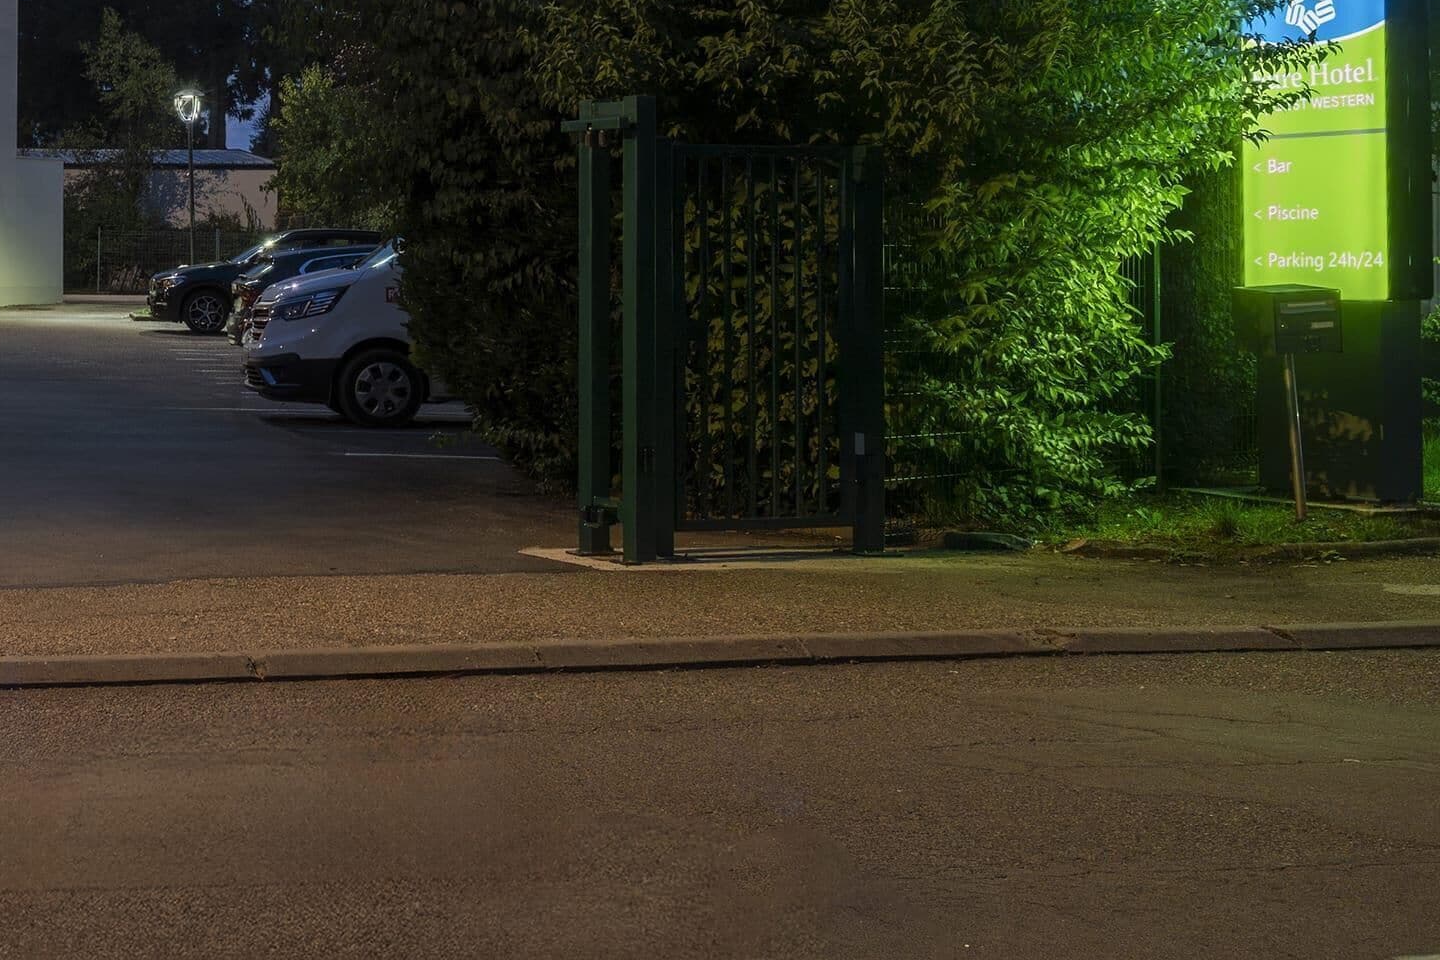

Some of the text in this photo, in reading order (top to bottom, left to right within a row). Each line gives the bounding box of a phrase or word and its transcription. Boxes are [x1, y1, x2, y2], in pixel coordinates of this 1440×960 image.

[1310, 57, 1373, 87] Hotel
[1312, 93, 1375, 109] WESTERN
[1267, 158, 1293, 174] Bar
[1267, 205, 1320, 221] Piscine
[1267, 251, 1384, 272] Parking 24h/24
